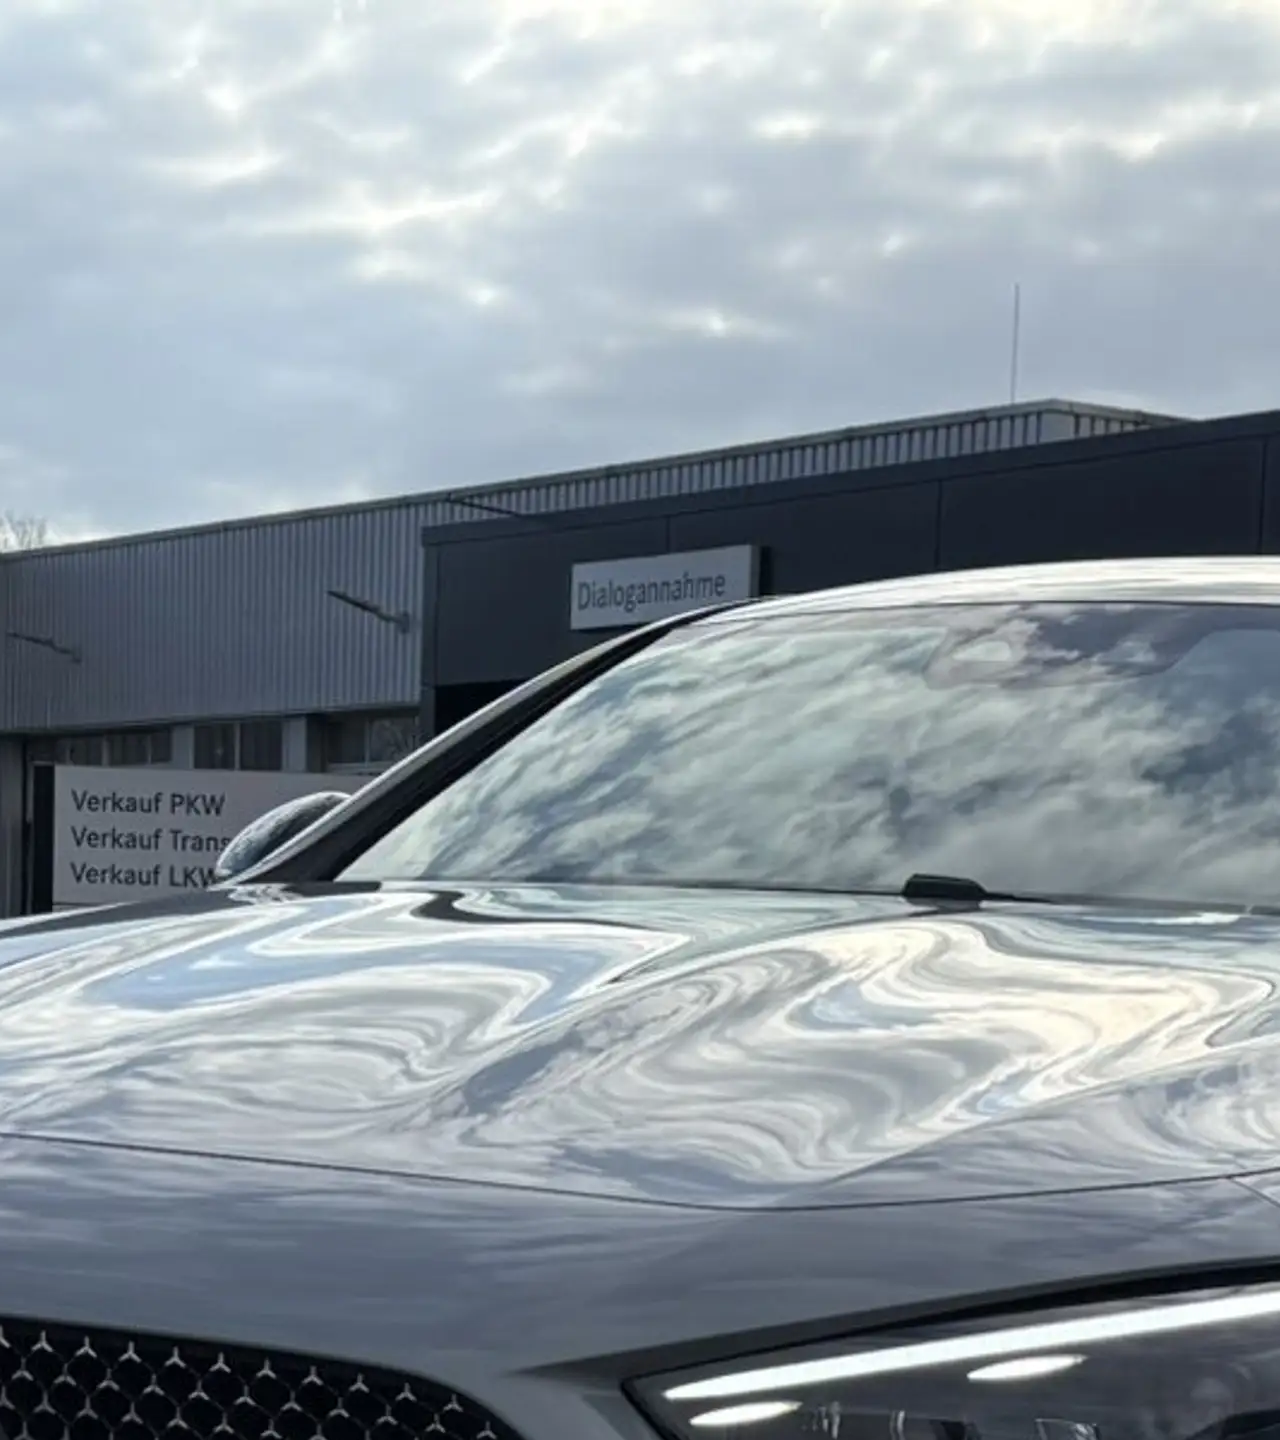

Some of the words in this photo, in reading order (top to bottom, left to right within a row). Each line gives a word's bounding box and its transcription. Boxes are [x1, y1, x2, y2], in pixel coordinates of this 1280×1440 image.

[577, 572, 726, 612] Dialogannahme
[71, 790, 163, 814] Verkauf
[171, 793, 226, 816] PKW
[71, 826, 162, 850] Verkauf
[70, 862, 161, 886] Verkauf
